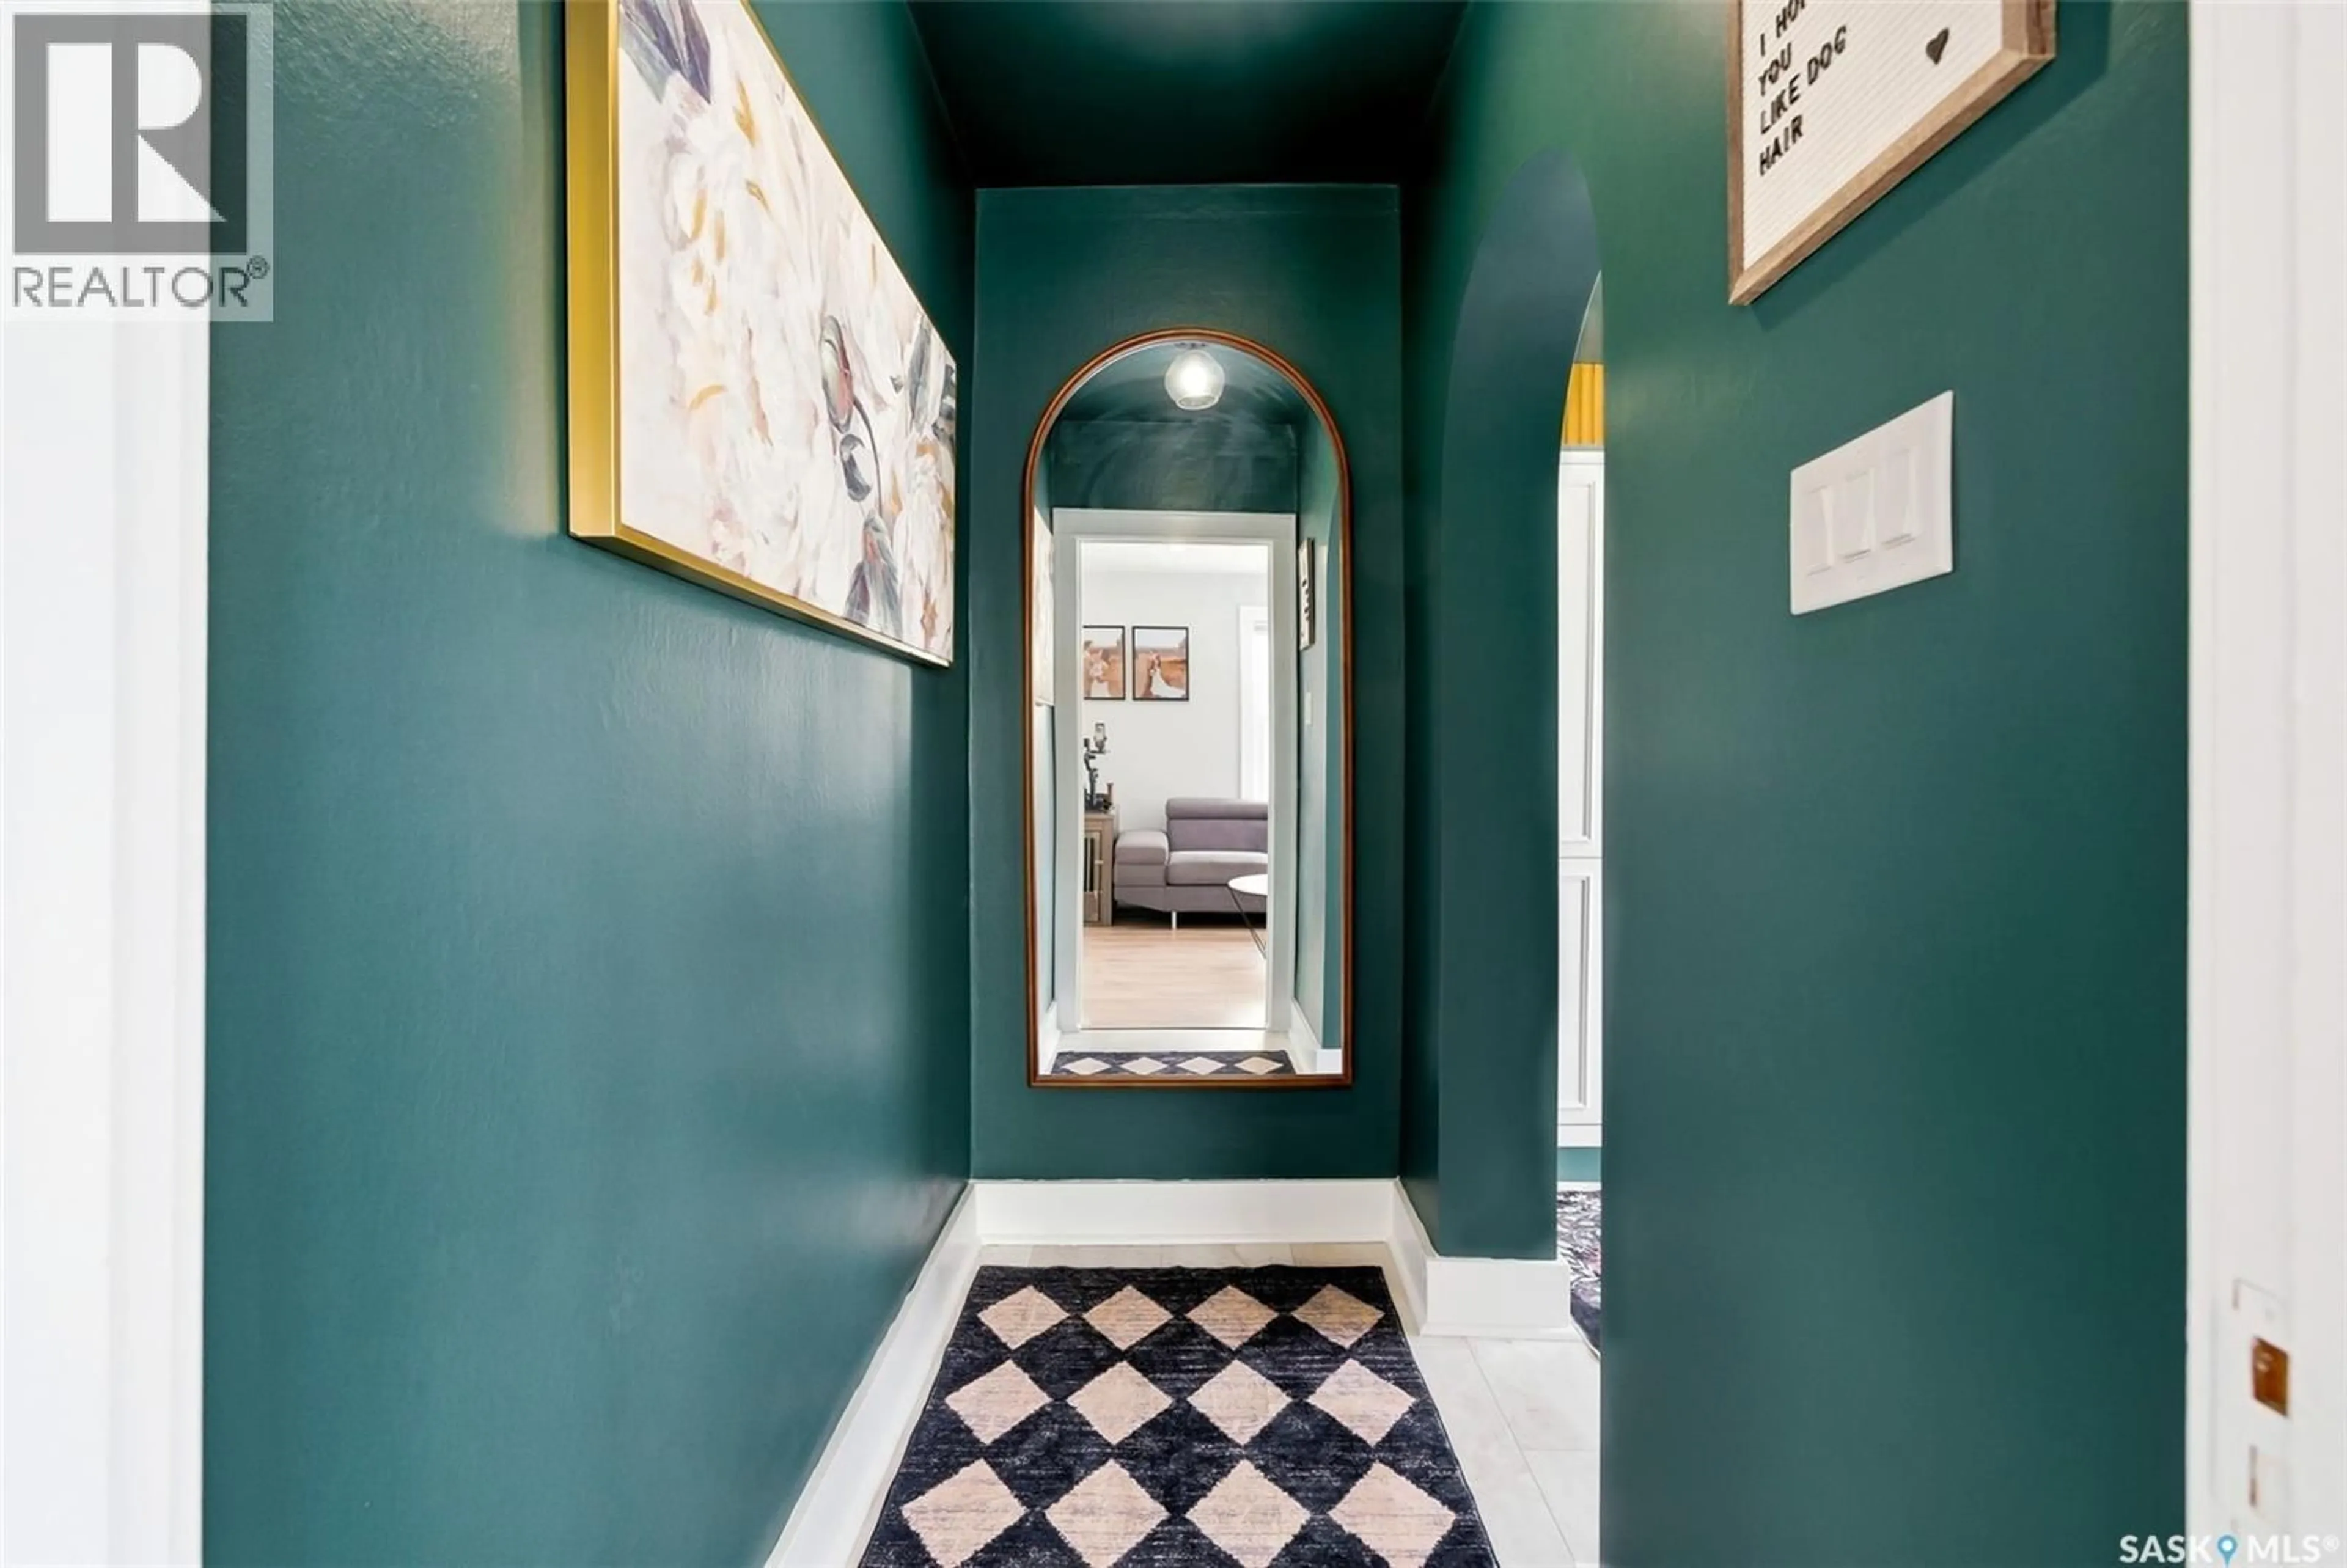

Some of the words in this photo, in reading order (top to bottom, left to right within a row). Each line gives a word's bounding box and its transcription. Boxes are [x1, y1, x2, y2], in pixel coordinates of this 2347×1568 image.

[1758, 42, 1791, 97] YOU
[1760, 33, 1765, 57] I
[1760, 73, 1800, 135] LIKE
[1807, 25, 1846, 86] DOG
[1759, 114, 1803, 177] HAIR
